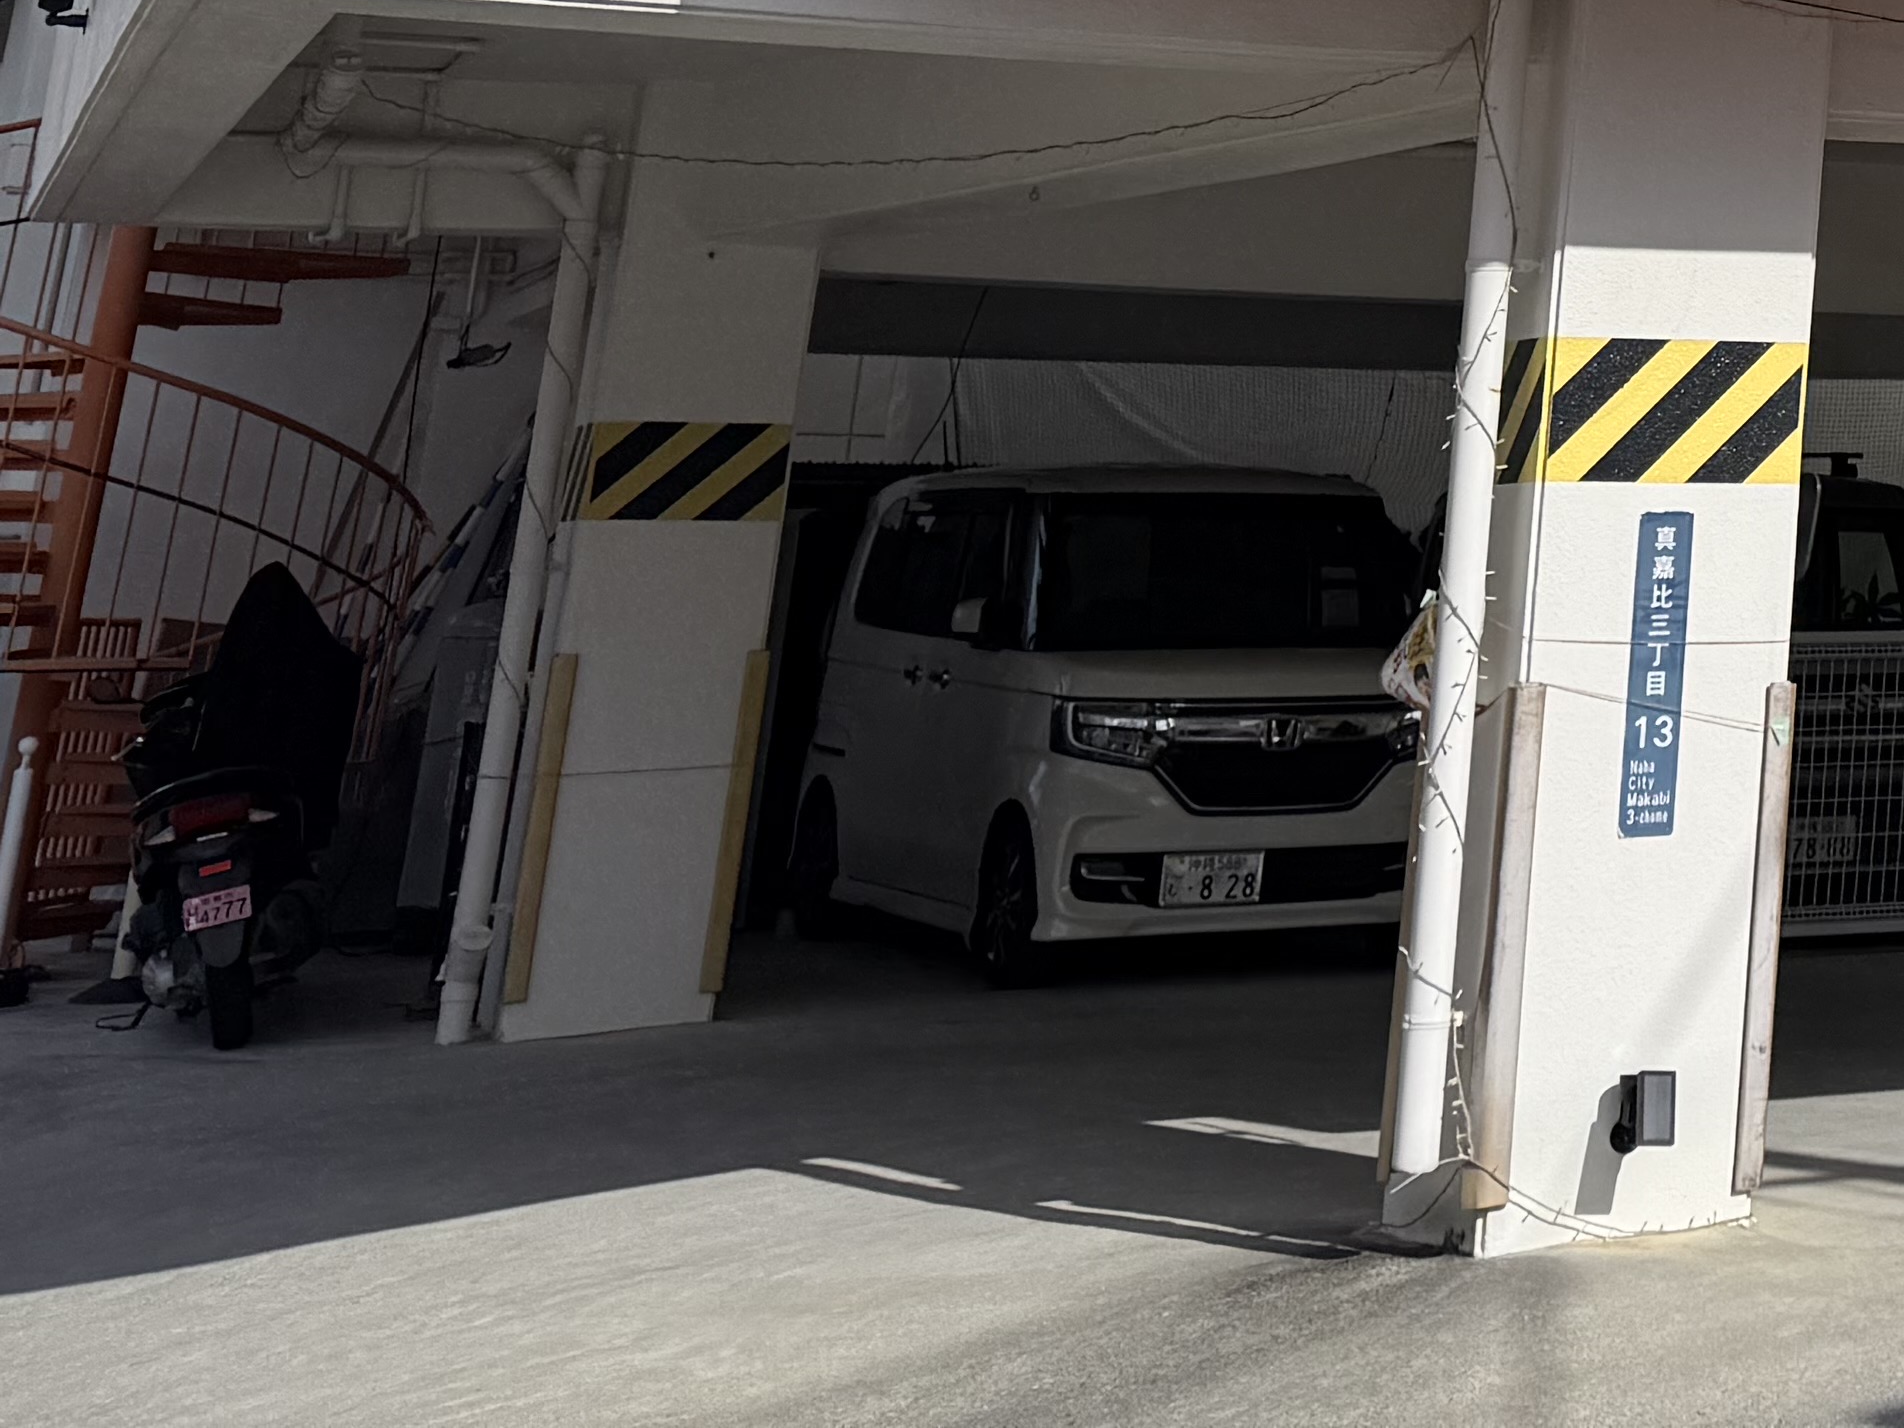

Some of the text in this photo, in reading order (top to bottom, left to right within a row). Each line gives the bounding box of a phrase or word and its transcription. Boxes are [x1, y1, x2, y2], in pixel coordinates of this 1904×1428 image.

[1646, 526, 1677, 696] 真嘉比三丁目
[1635, 715, 1674, 748] 13
[1630, 760, 1655, 774] Naha
[1628, 776, 1655, 790] City
[1626, 790, 1670, 807] Makabi
[1626, 809, 1668, 825] 3-chome
